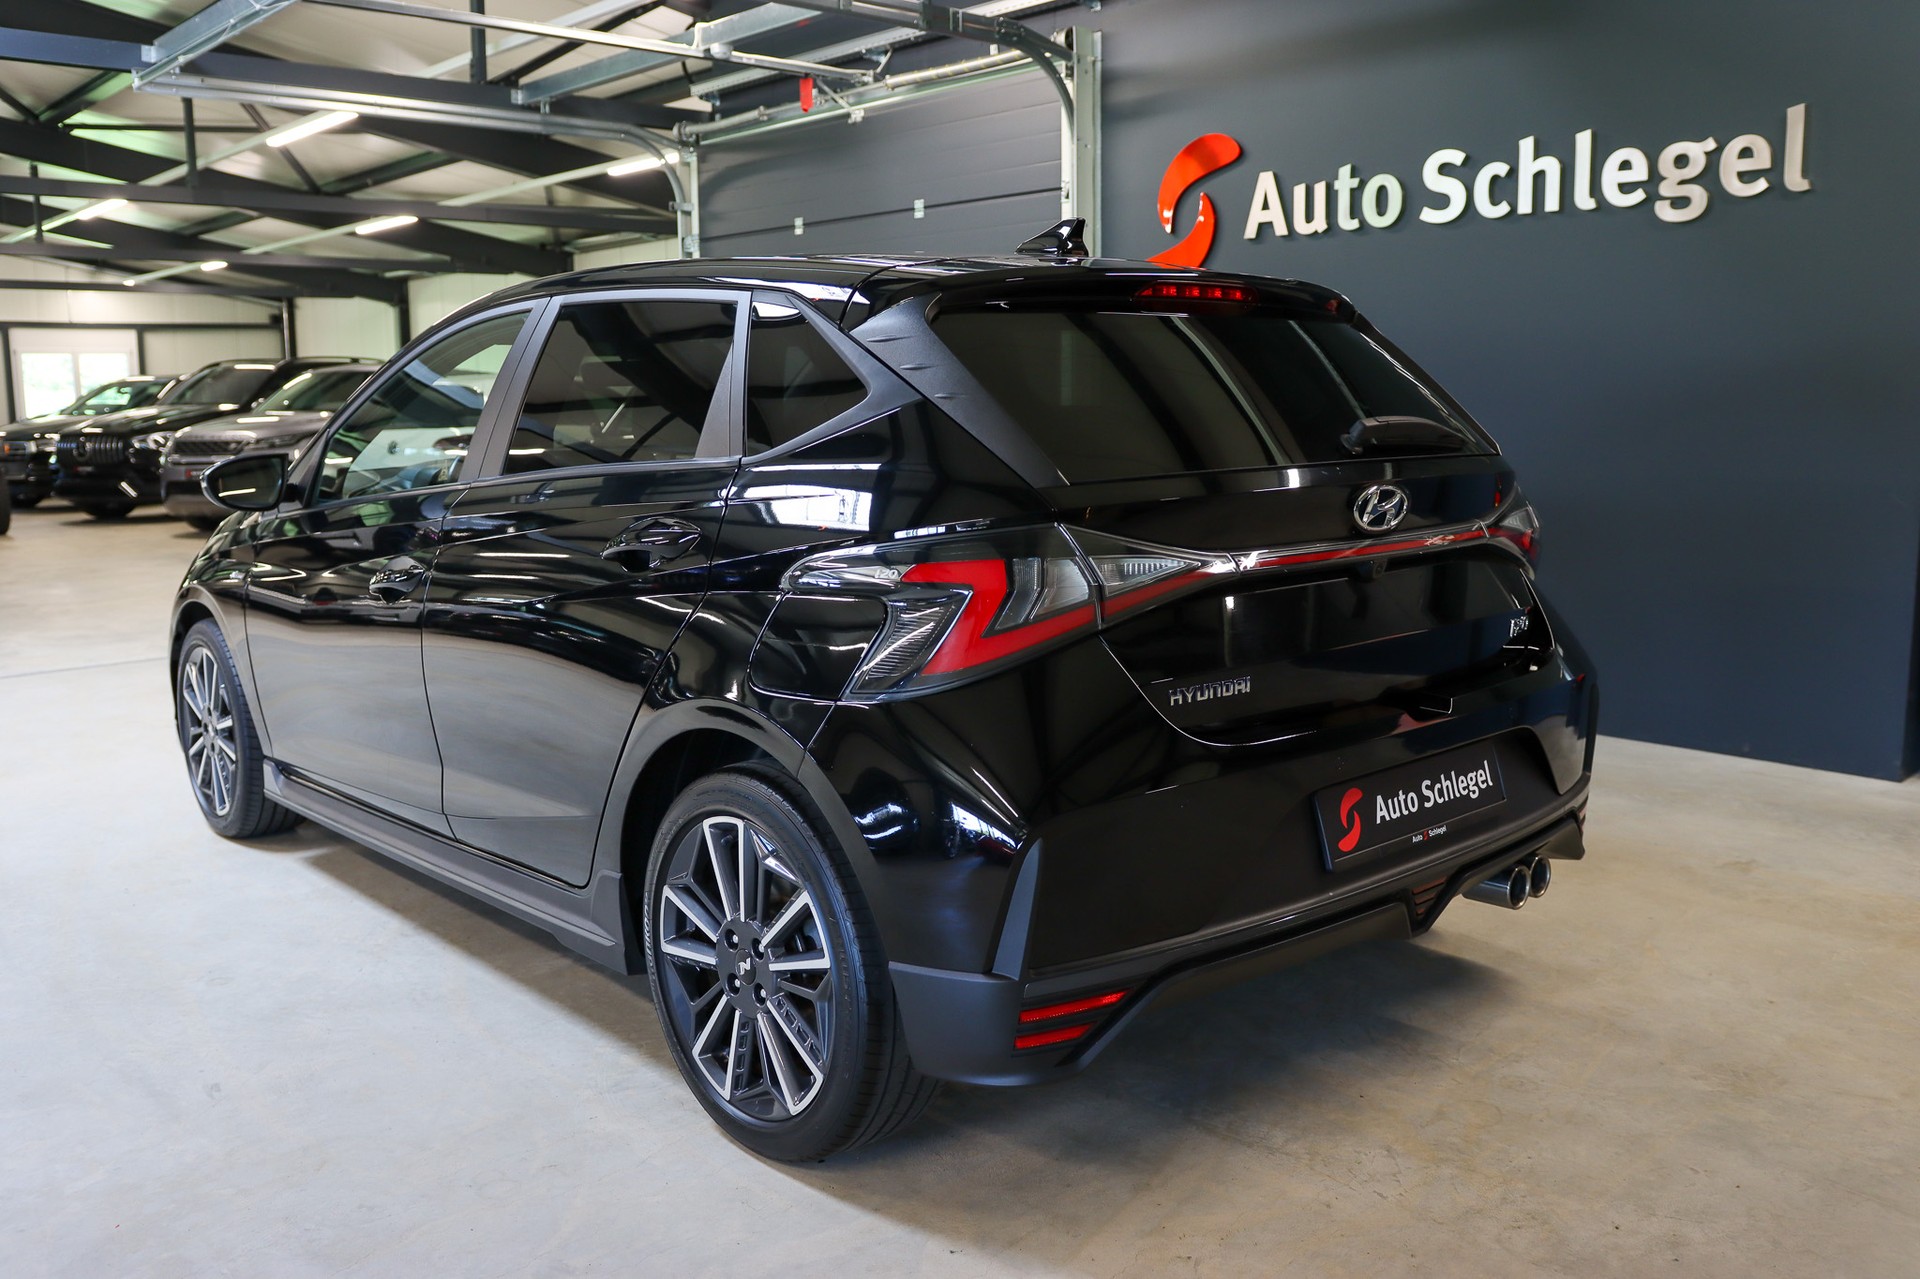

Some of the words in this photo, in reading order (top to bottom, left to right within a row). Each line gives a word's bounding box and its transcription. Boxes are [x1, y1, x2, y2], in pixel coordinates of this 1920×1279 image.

[1243, 162, 1403, 240] Auto
[1418, 103, 1811, 223] Schlegel
[1168, 676, 1251, 706] HYUNDAI
[1376, 789, 1418, 825] Auto
[1421, 759, 1493, 808] Schlegel
[1412, 834, 1423, 843] Auto
[1428, 824, 1447, 837] Schlegel
